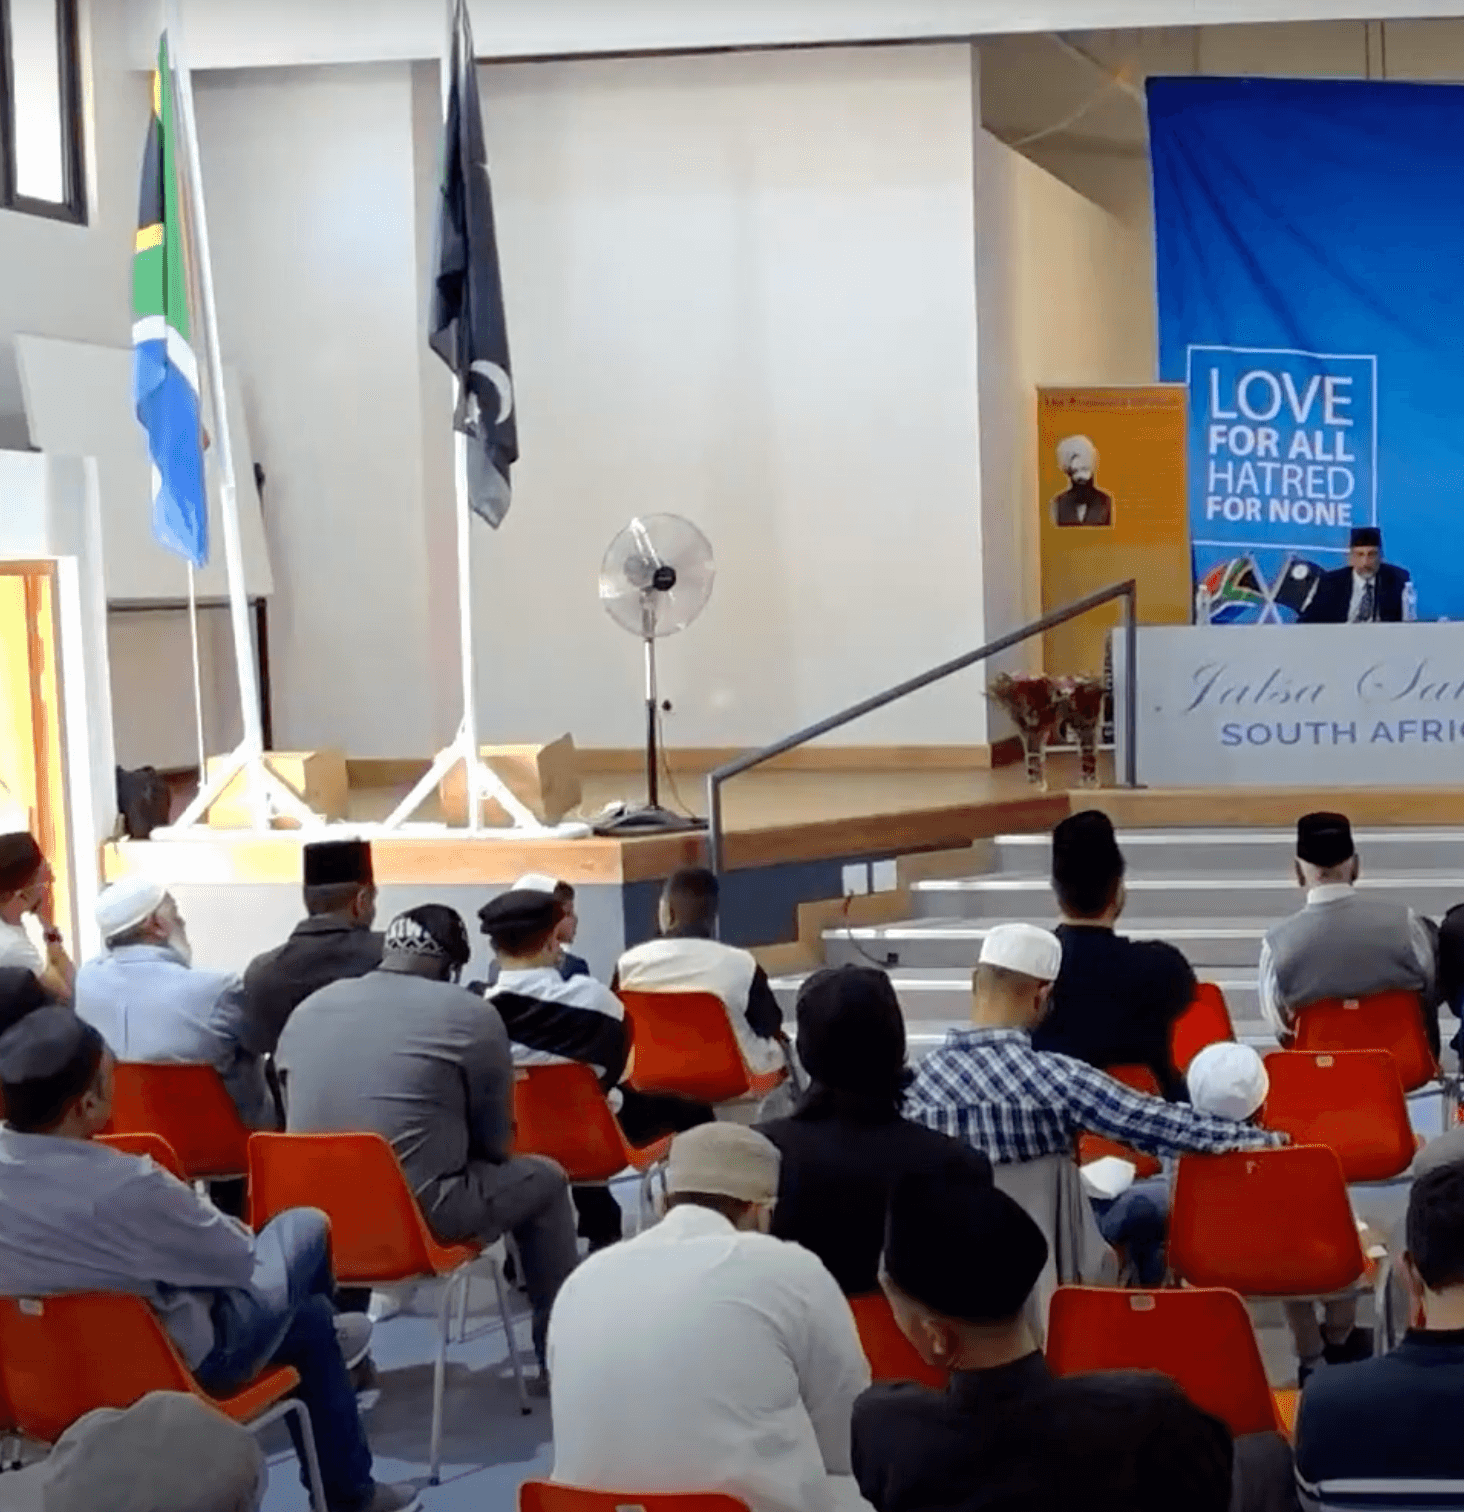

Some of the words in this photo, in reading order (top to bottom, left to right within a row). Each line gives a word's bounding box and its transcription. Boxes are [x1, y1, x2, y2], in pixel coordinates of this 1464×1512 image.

[1210, 367, 1354, 427] LOVE
[1209, 424, 1280, 458] FOR
[1288, 430, 1355, 462] ALL
[1208, 460, 1355, 500] HATRED
[1206, 496, 1262, 522] FOR
[1269, 498, 1353, 527] NONE
[1160, 662, 1326, 715] Jalsa
[1221, 721, 1357, 747] SOUTH
